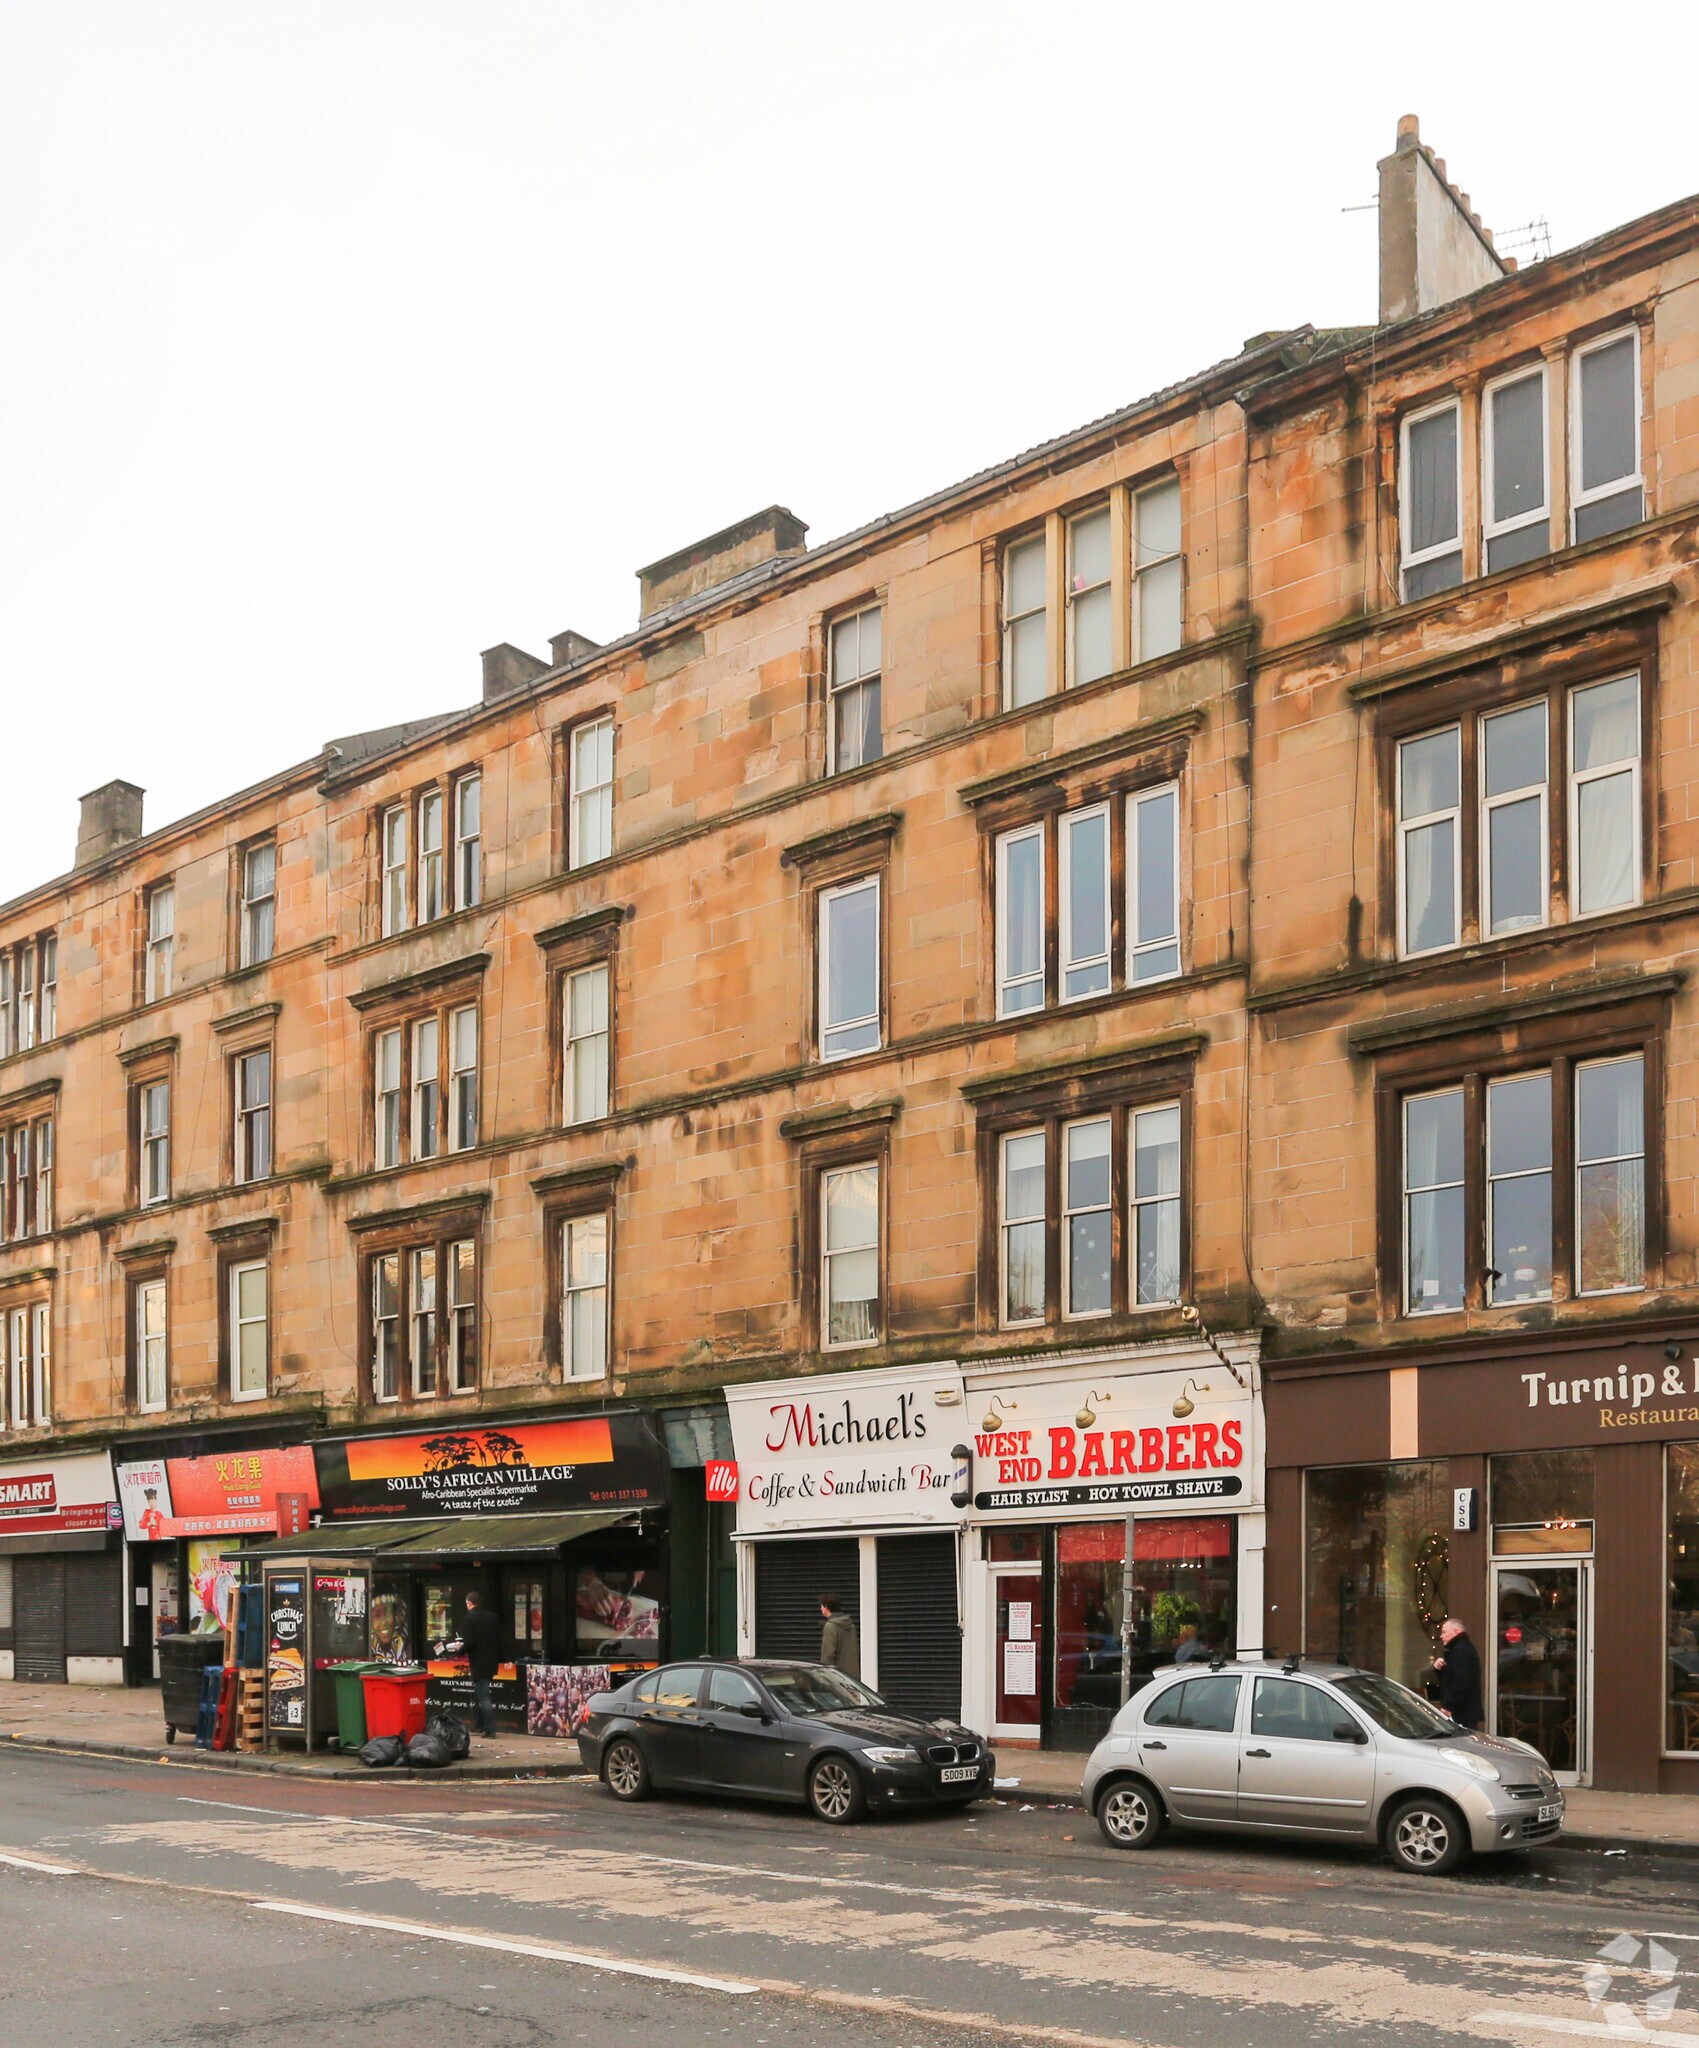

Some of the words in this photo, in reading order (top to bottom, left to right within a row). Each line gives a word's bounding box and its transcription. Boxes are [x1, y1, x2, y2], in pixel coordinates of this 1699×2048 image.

[1520, 1364, 1656, 1408] Turnip
[1661, 1365, 1686, 1396] &
[765, 1392, 927, 1452] Michael's
[974, 1430, 1031, 1457] WEST
[1047, 1420, 1243, 1479] BARBERS
[387, 1475, 441, 1491] SOLLY'S
[443, 1470, 503, 1488] AFRICAN
[506, 1465, 573, 1483] VILLAGE
[708, 1465, 737, 1498] illy
[998, 1457, 1042, 1484] END
[422, 1489, 466, 1500] Afro-Caribbean
[467, 1487, 496, 1498] Specialist
[497, 1484, 537, 1497] Supermarket
[601, 1490, 616, 1500] 0141
[618, 1490, 630, 1499] 337
[749, 1472, 795, 1507] Coffee
[799, 1473, 816, 1497] &
[819, 1466, 906, 1496] Sandwich
[910, 1463, 951, 1490] Bar
[990, 1492, 1024, 1507] HAIR
[1026, 1489, 1069, 1505] SYLIST
[1088, 1487, 1120, 1501] HOT
[1122, 1483, 1173, 1499] TOWEL
[1175, 1480, 1223, 1496] SHAVE
[452, 1500, 471, 1509] taste
[472, 1498, 481, 1510] of
[482, 1498, 495, 1507] the
[270, 1607, 304, 1625] CHRISTMAS
[277, 1621, 297, 1635] LUNCH
